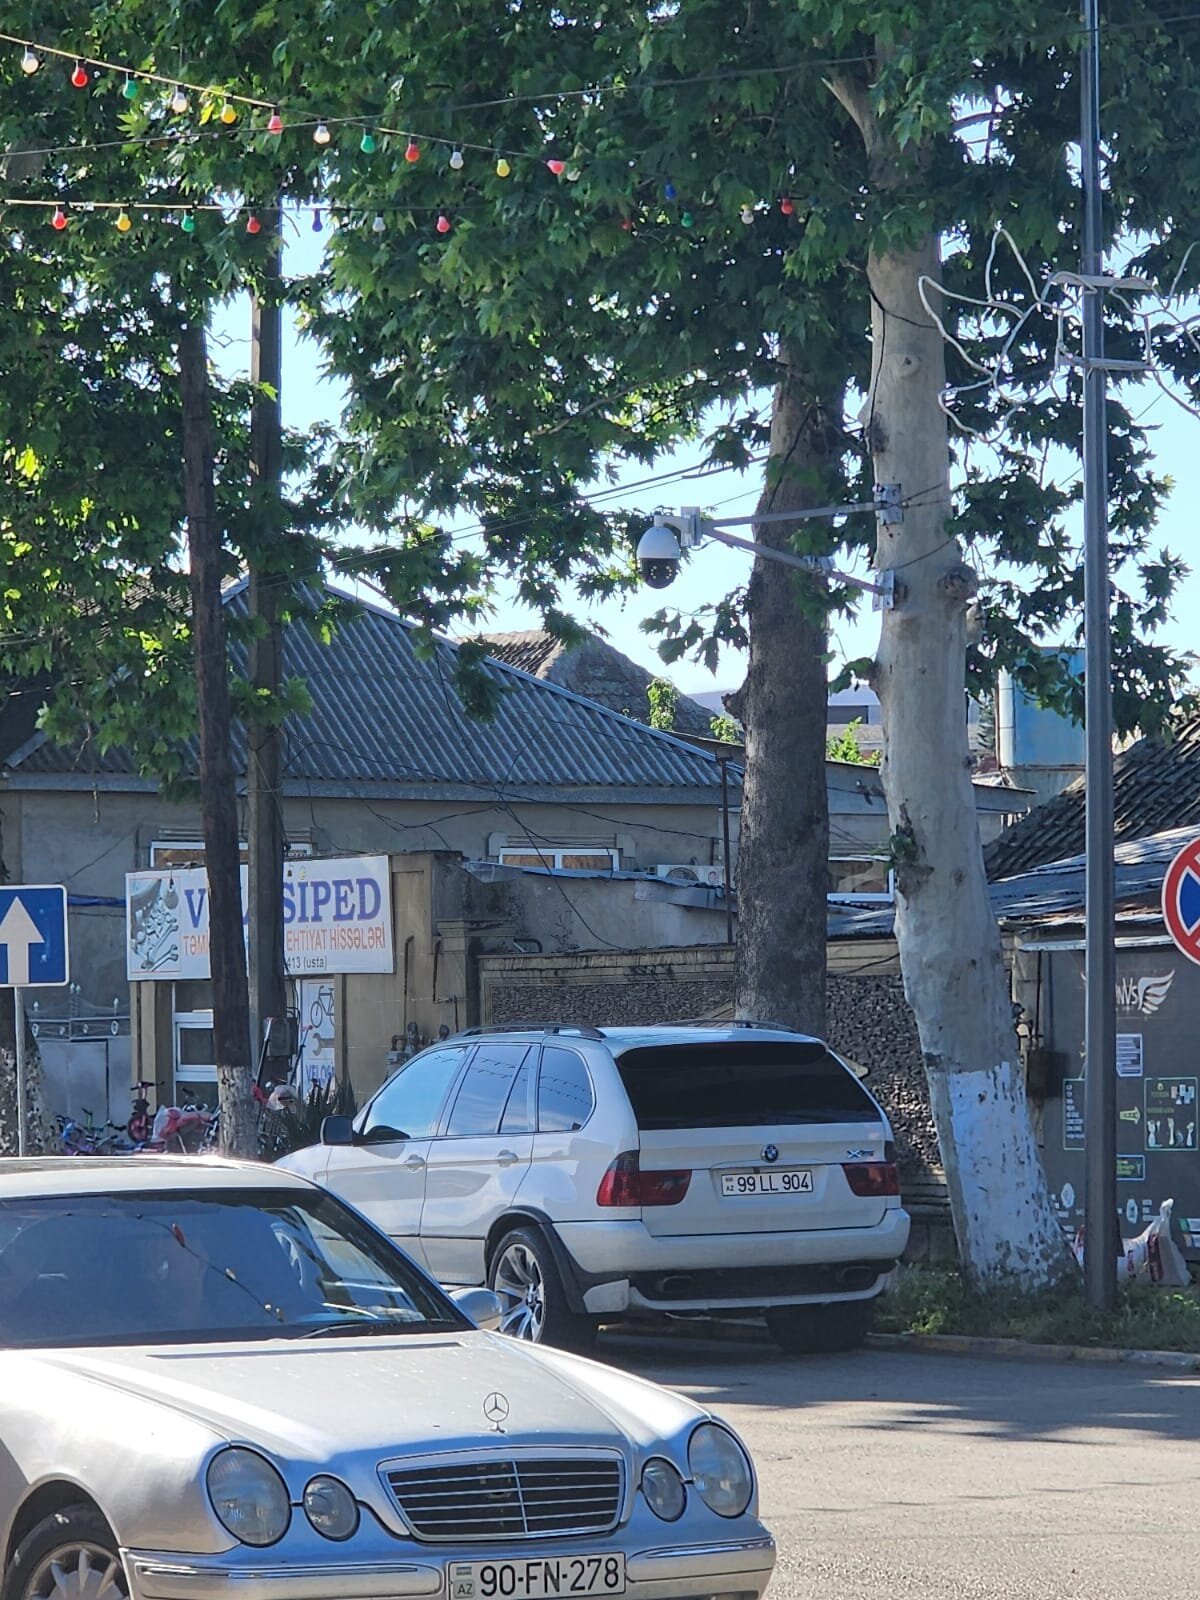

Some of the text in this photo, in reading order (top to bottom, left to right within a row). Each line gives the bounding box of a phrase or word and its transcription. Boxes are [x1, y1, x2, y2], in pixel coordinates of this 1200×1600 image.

[287, 926, 327, 951] EHTİYAT
[330, 922, 386, 949] HİSSƏLƏRİ
[304, 955, 328, 971] (usta)
[737, 1173, 809, 1193] 99 LL 904
[480, 1557, 619, 1597] 90-FN-278
[457, 1583, 473, 1595] AZ
